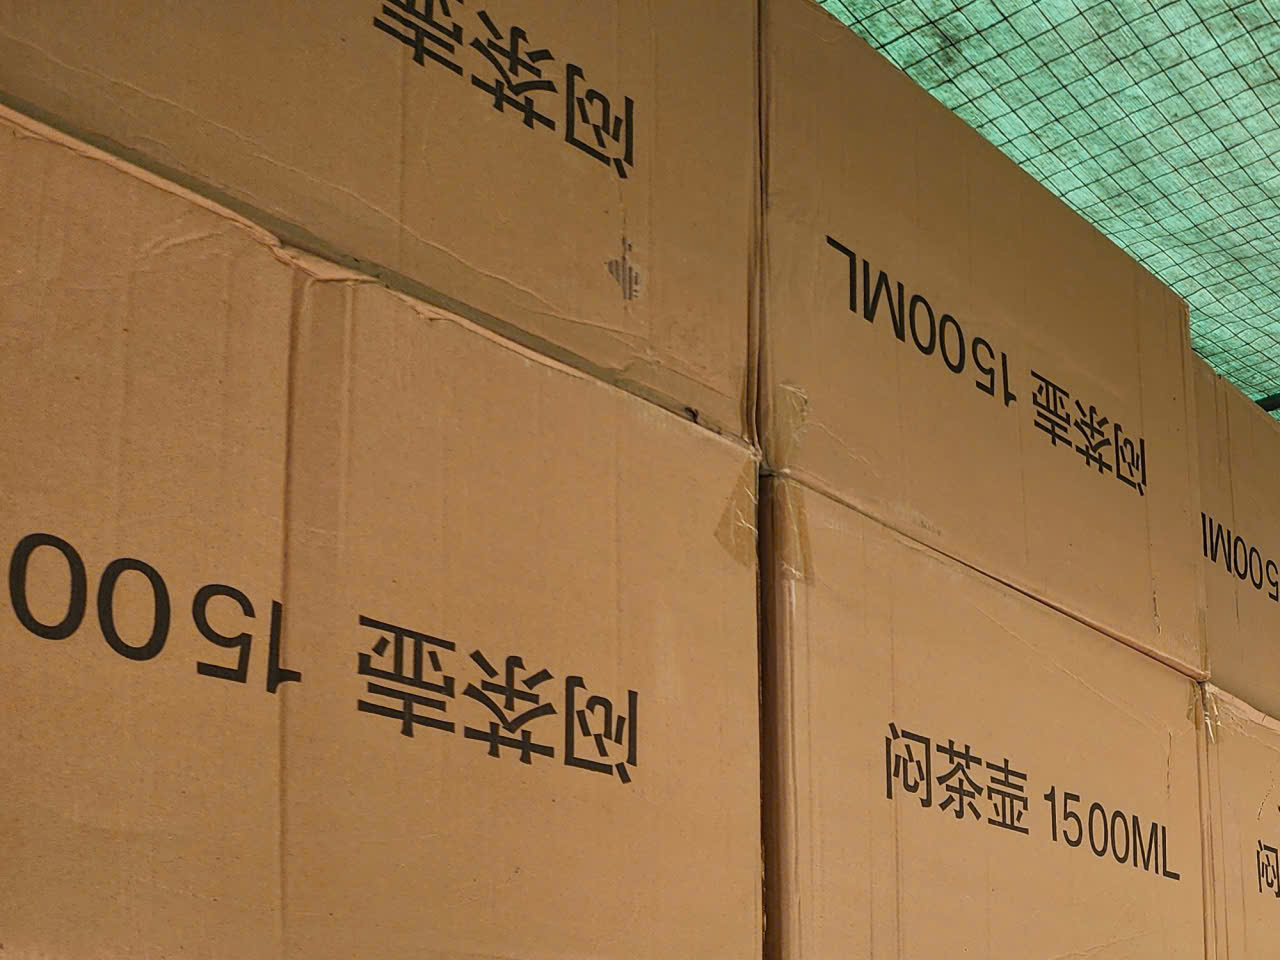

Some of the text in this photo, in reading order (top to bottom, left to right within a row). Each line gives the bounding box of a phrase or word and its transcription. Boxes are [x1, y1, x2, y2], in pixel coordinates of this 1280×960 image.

[826, 234, 1147, 497] 闷茶壶 1500ML
[8, 532, 639, 784] 闷茶壶 1500
[885, 722, 1181, 882] 闷茶壶 1500ML
